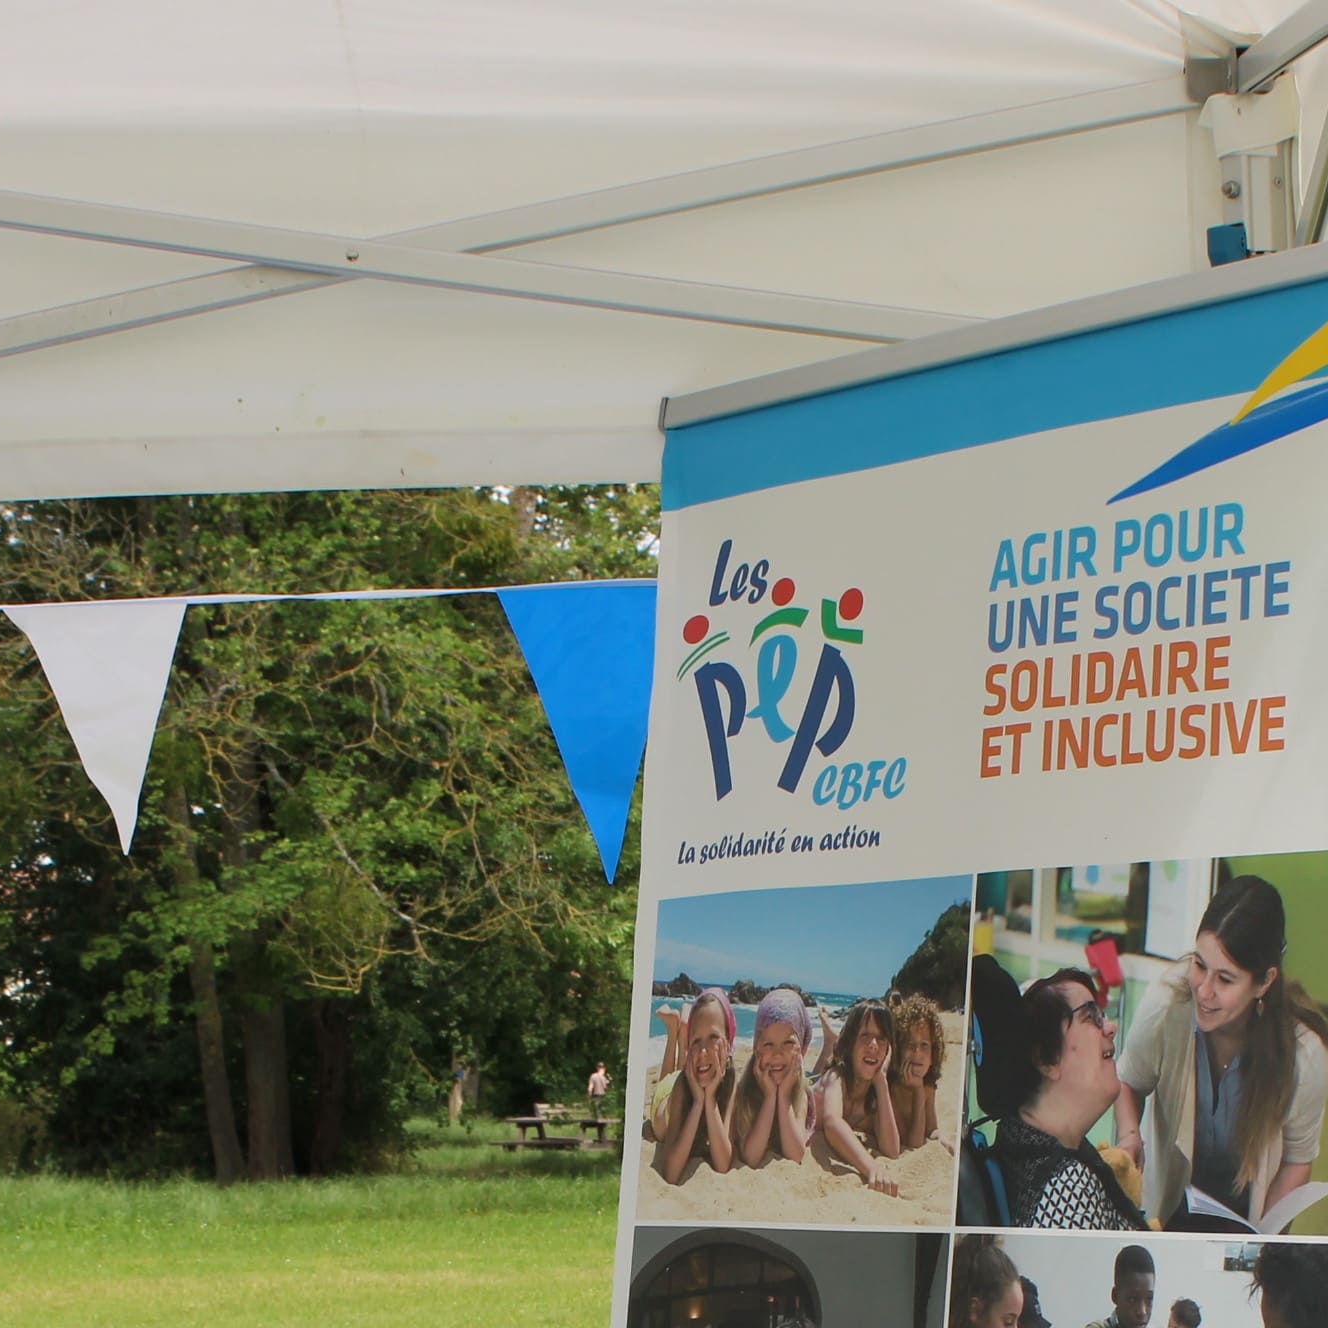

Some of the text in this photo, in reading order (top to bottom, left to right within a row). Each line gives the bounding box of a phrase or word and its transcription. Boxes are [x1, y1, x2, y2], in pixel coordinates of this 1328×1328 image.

[708, 538, 770, 608] Les
[989, 501, 1246, 592] AGIR POUR
[987, 560, 1293, 653] UNE SOCIETE
[983, 634, 1232, 717] SOLIDAIRE
[979, 695, 1287, 780] ET INCLUSIVE
[812, 757, 908, 809] CBFC
[678, 824, 881, 864] La solidarité en action
